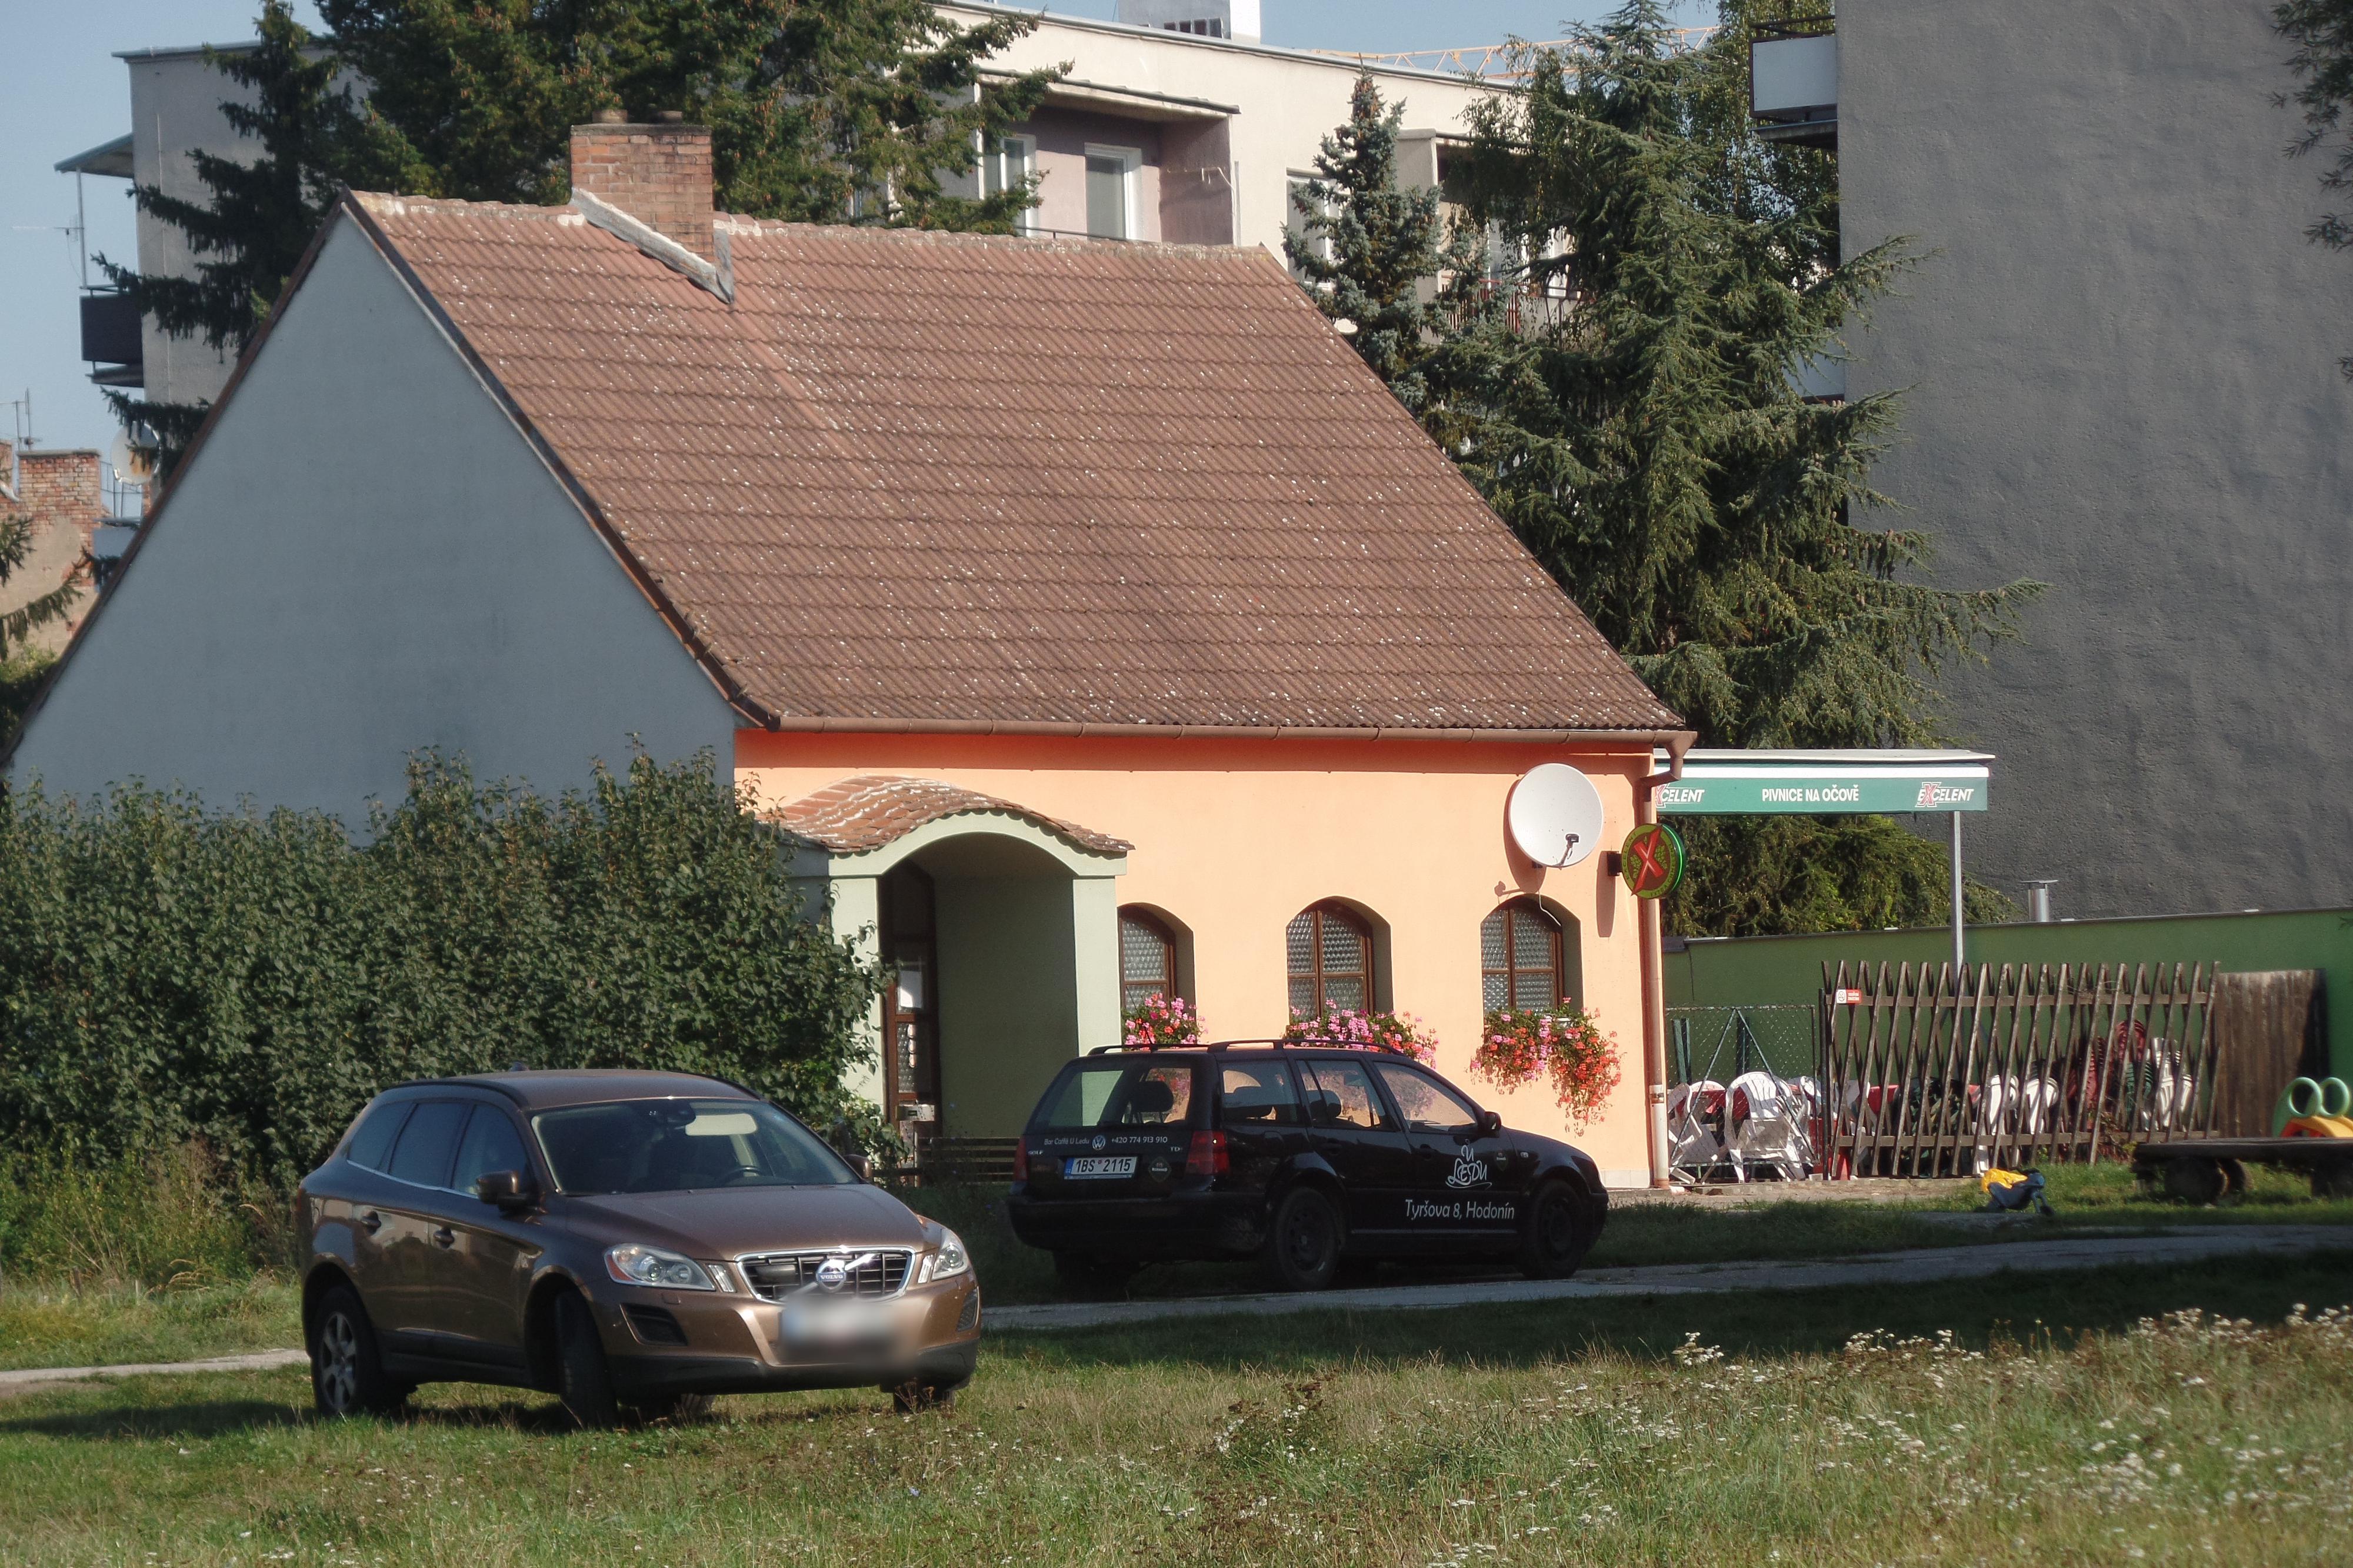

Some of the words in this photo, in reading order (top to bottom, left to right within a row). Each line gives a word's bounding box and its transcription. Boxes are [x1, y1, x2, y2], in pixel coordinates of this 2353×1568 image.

[1656, 783, 1705, 806] XCELENT
[1762, 788, 1802, 802] PIVNICE
[1805, 788, 1820, 802] NA
[1822, 784, 1859, 802] OČOVĚ
[1917, 783, 1974, 806] EXCELENT
[1076, 1159, 1095, 1173] 1BS
[1103, 1159, 1132, 1172] 2115
[1405, 1199, 1451, 1220] Tyršova
[1453, 1203, 1462, 1220] 8,
[1466, 1201, 1515, 1219] Hodonín
